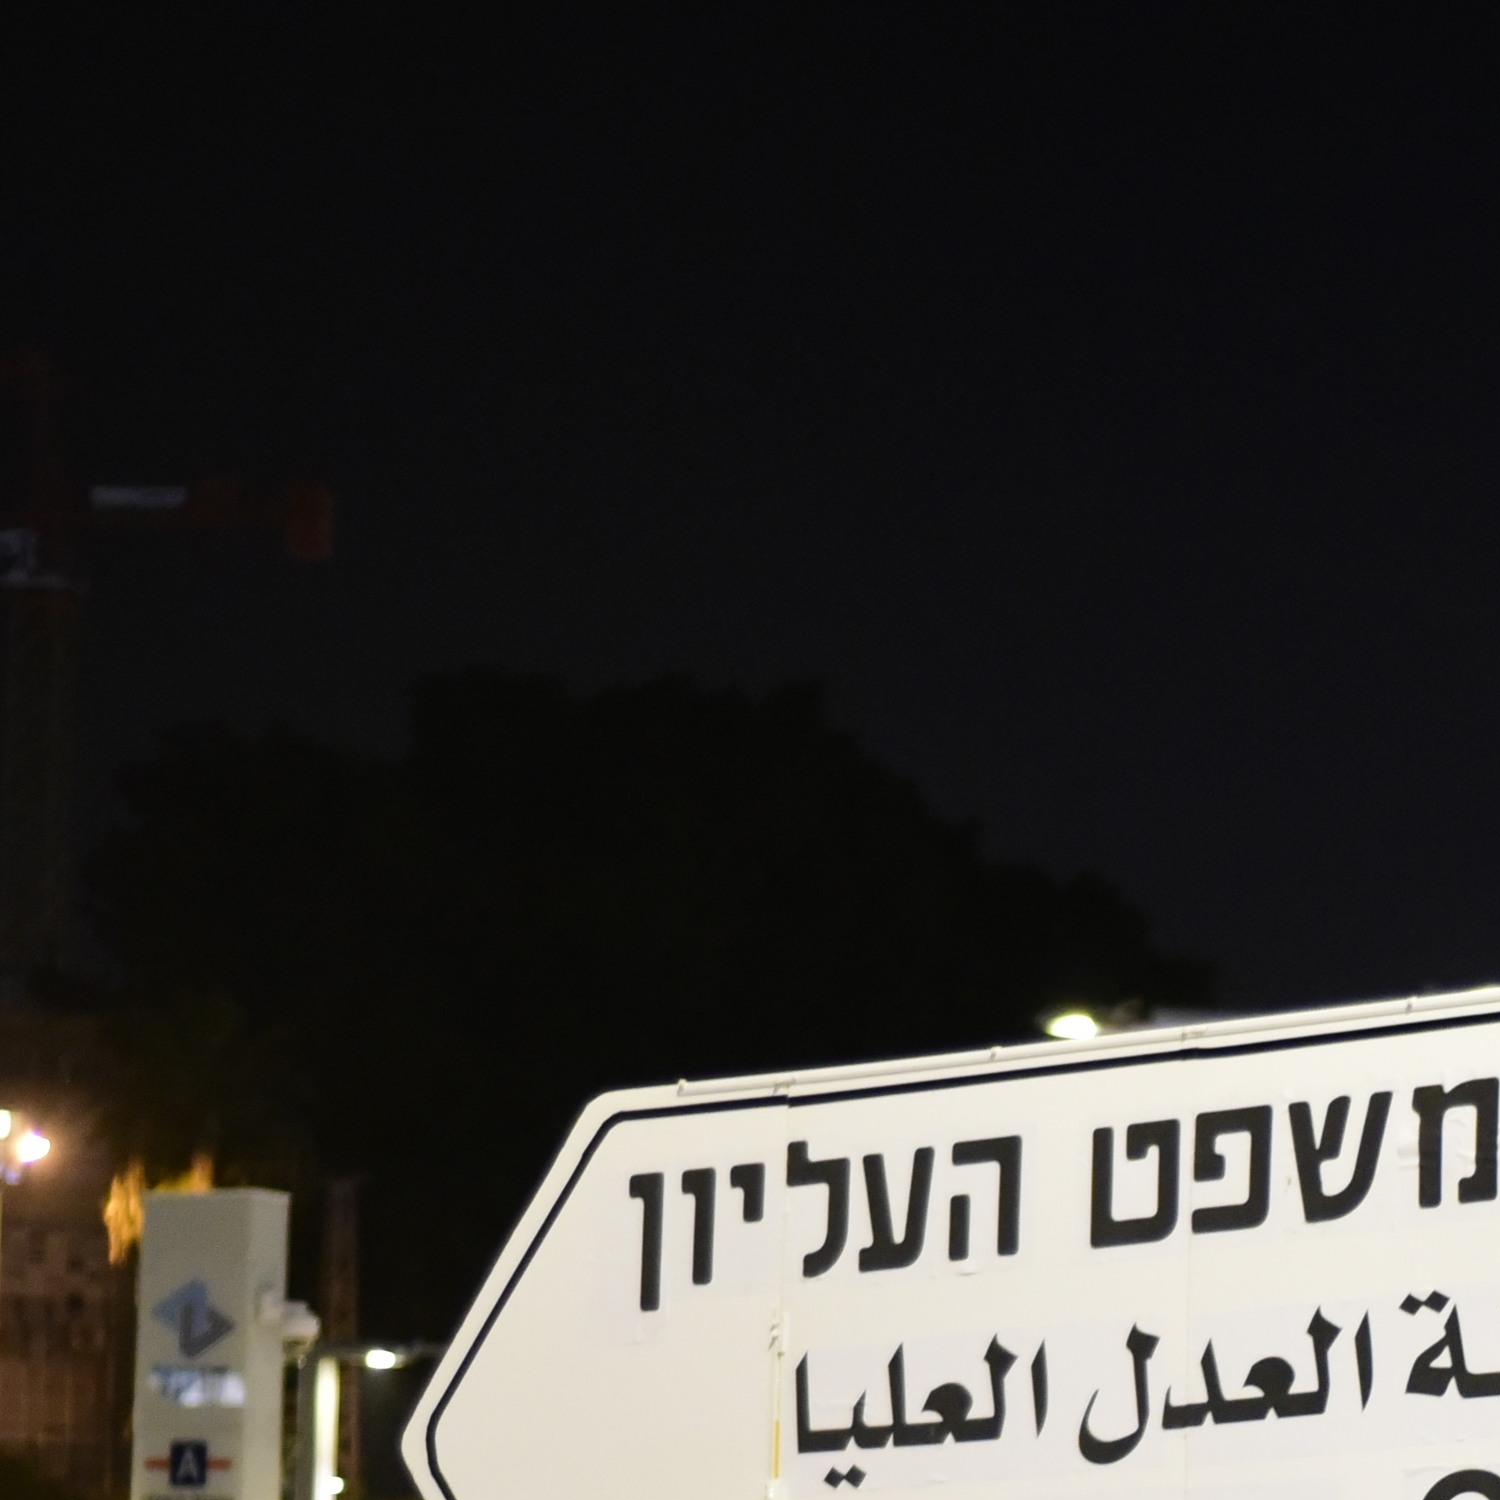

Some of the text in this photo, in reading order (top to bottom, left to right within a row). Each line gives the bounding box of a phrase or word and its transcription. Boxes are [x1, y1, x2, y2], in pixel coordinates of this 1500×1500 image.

[629, 1135, 1022, 1312] העליון
[795, 1336, 1047, 1488] العليا
[1078, 1308, 1373, 1465] العدل
